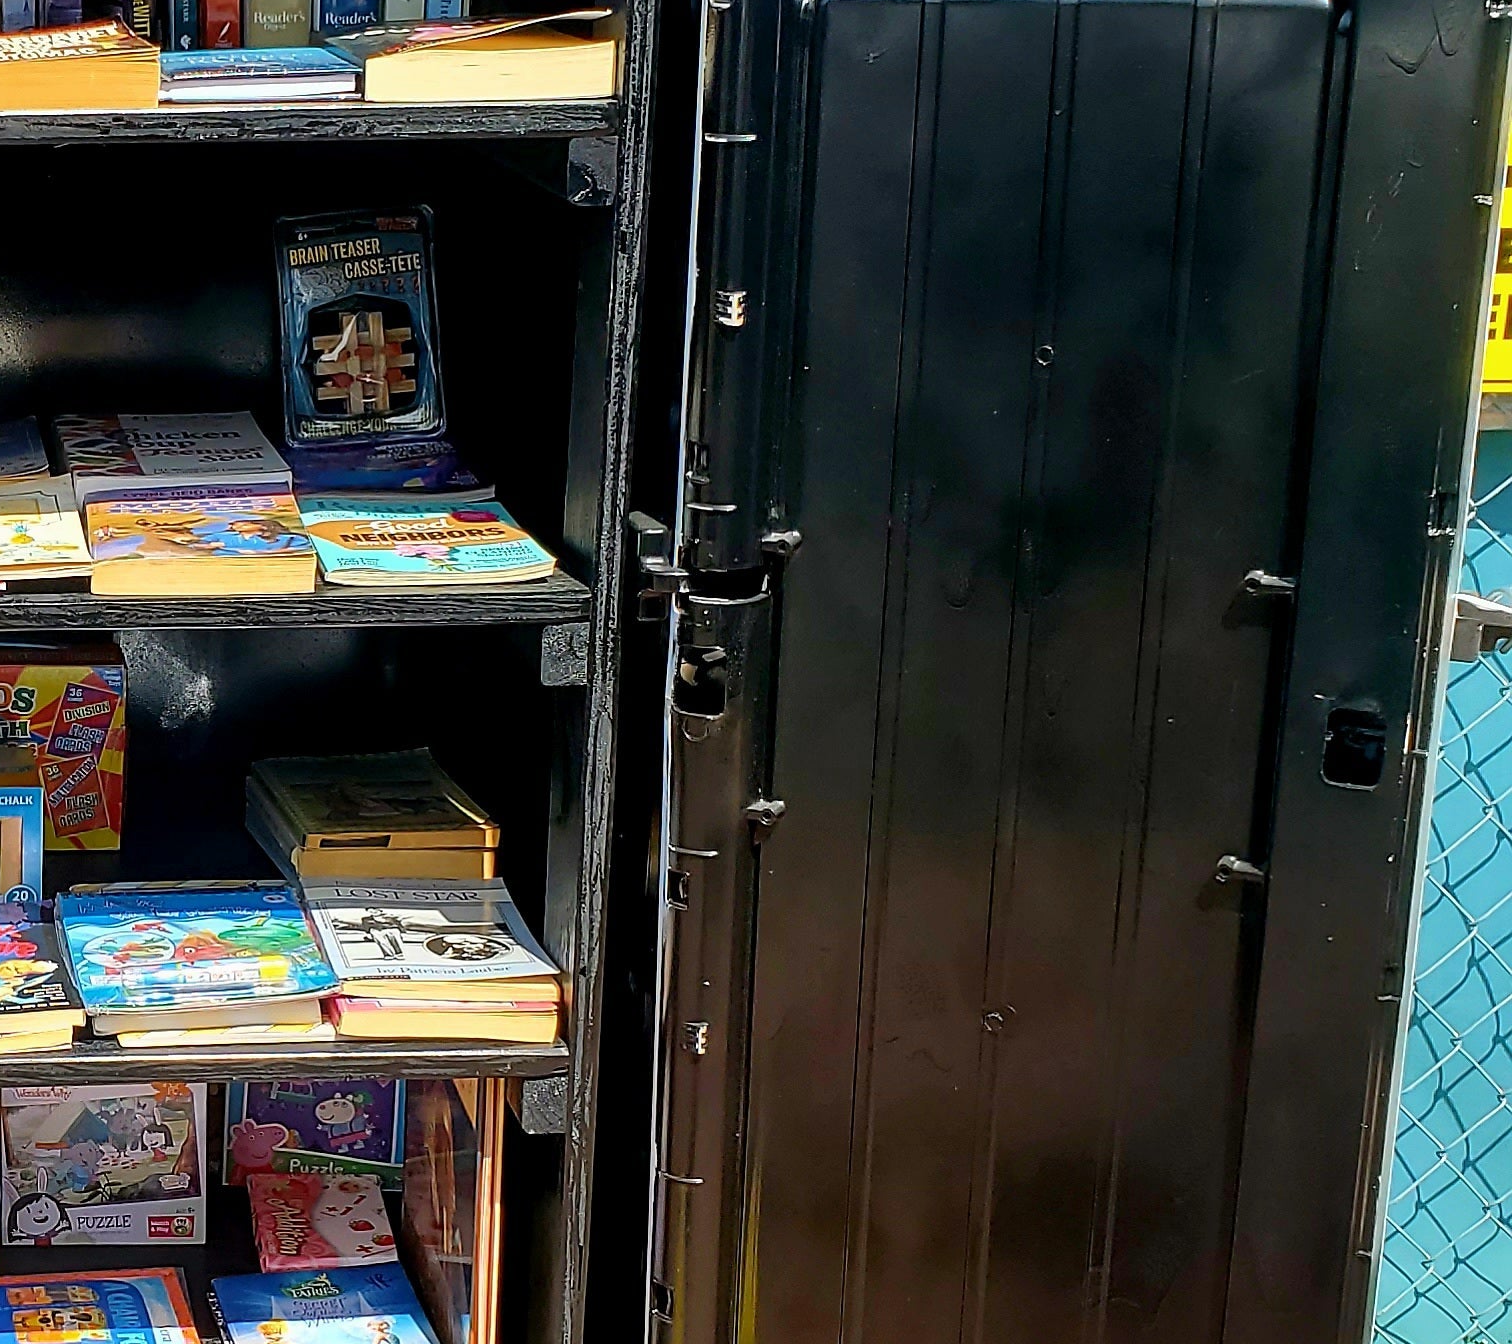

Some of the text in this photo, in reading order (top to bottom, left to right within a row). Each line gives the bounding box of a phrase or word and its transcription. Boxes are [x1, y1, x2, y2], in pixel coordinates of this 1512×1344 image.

[290, 238, 380, 266] BRAIN TEASER
[354, 519, 455, 534] Good
[340, 527, 505, 543] NEIGHBORS
[335, 887, 482, 901] LOST STAR
[77, 1215, 131, 1230] PUZZLE
